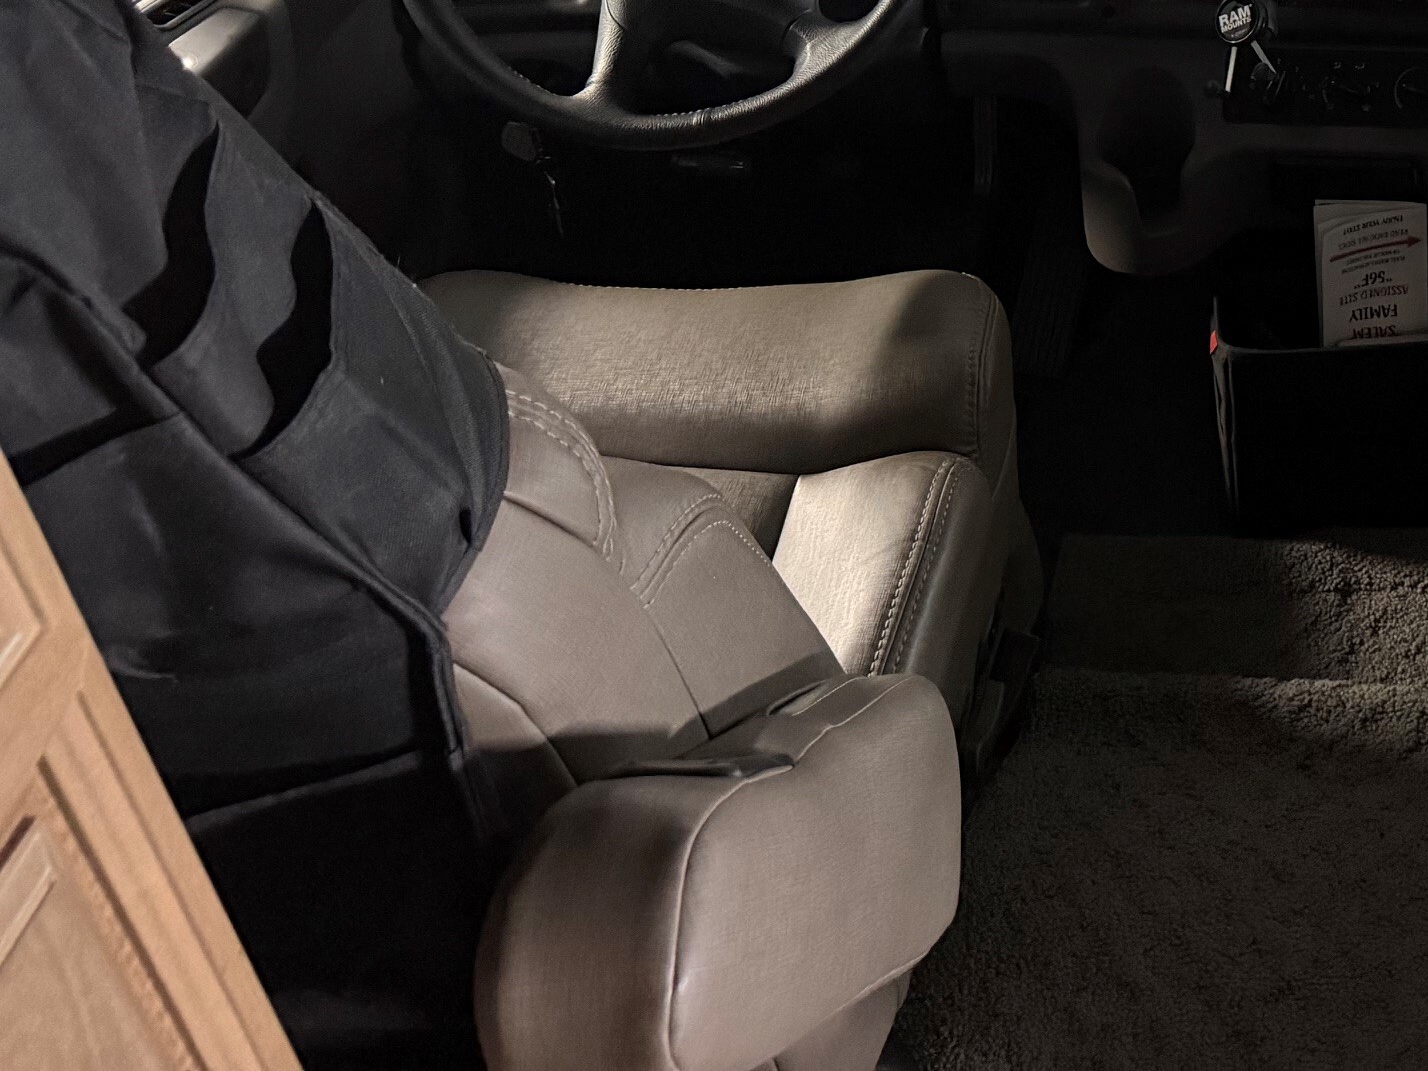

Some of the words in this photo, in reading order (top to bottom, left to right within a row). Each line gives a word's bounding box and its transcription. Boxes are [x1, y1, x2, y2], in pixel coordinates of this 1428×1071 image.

[1218, 4, 1251, 27] RAM
[1221, 17, 1252, 33] MOUNTS
[1350, 304, 1398, 323] FAMILY
[1352, 325, 1396, 339] SALEM
